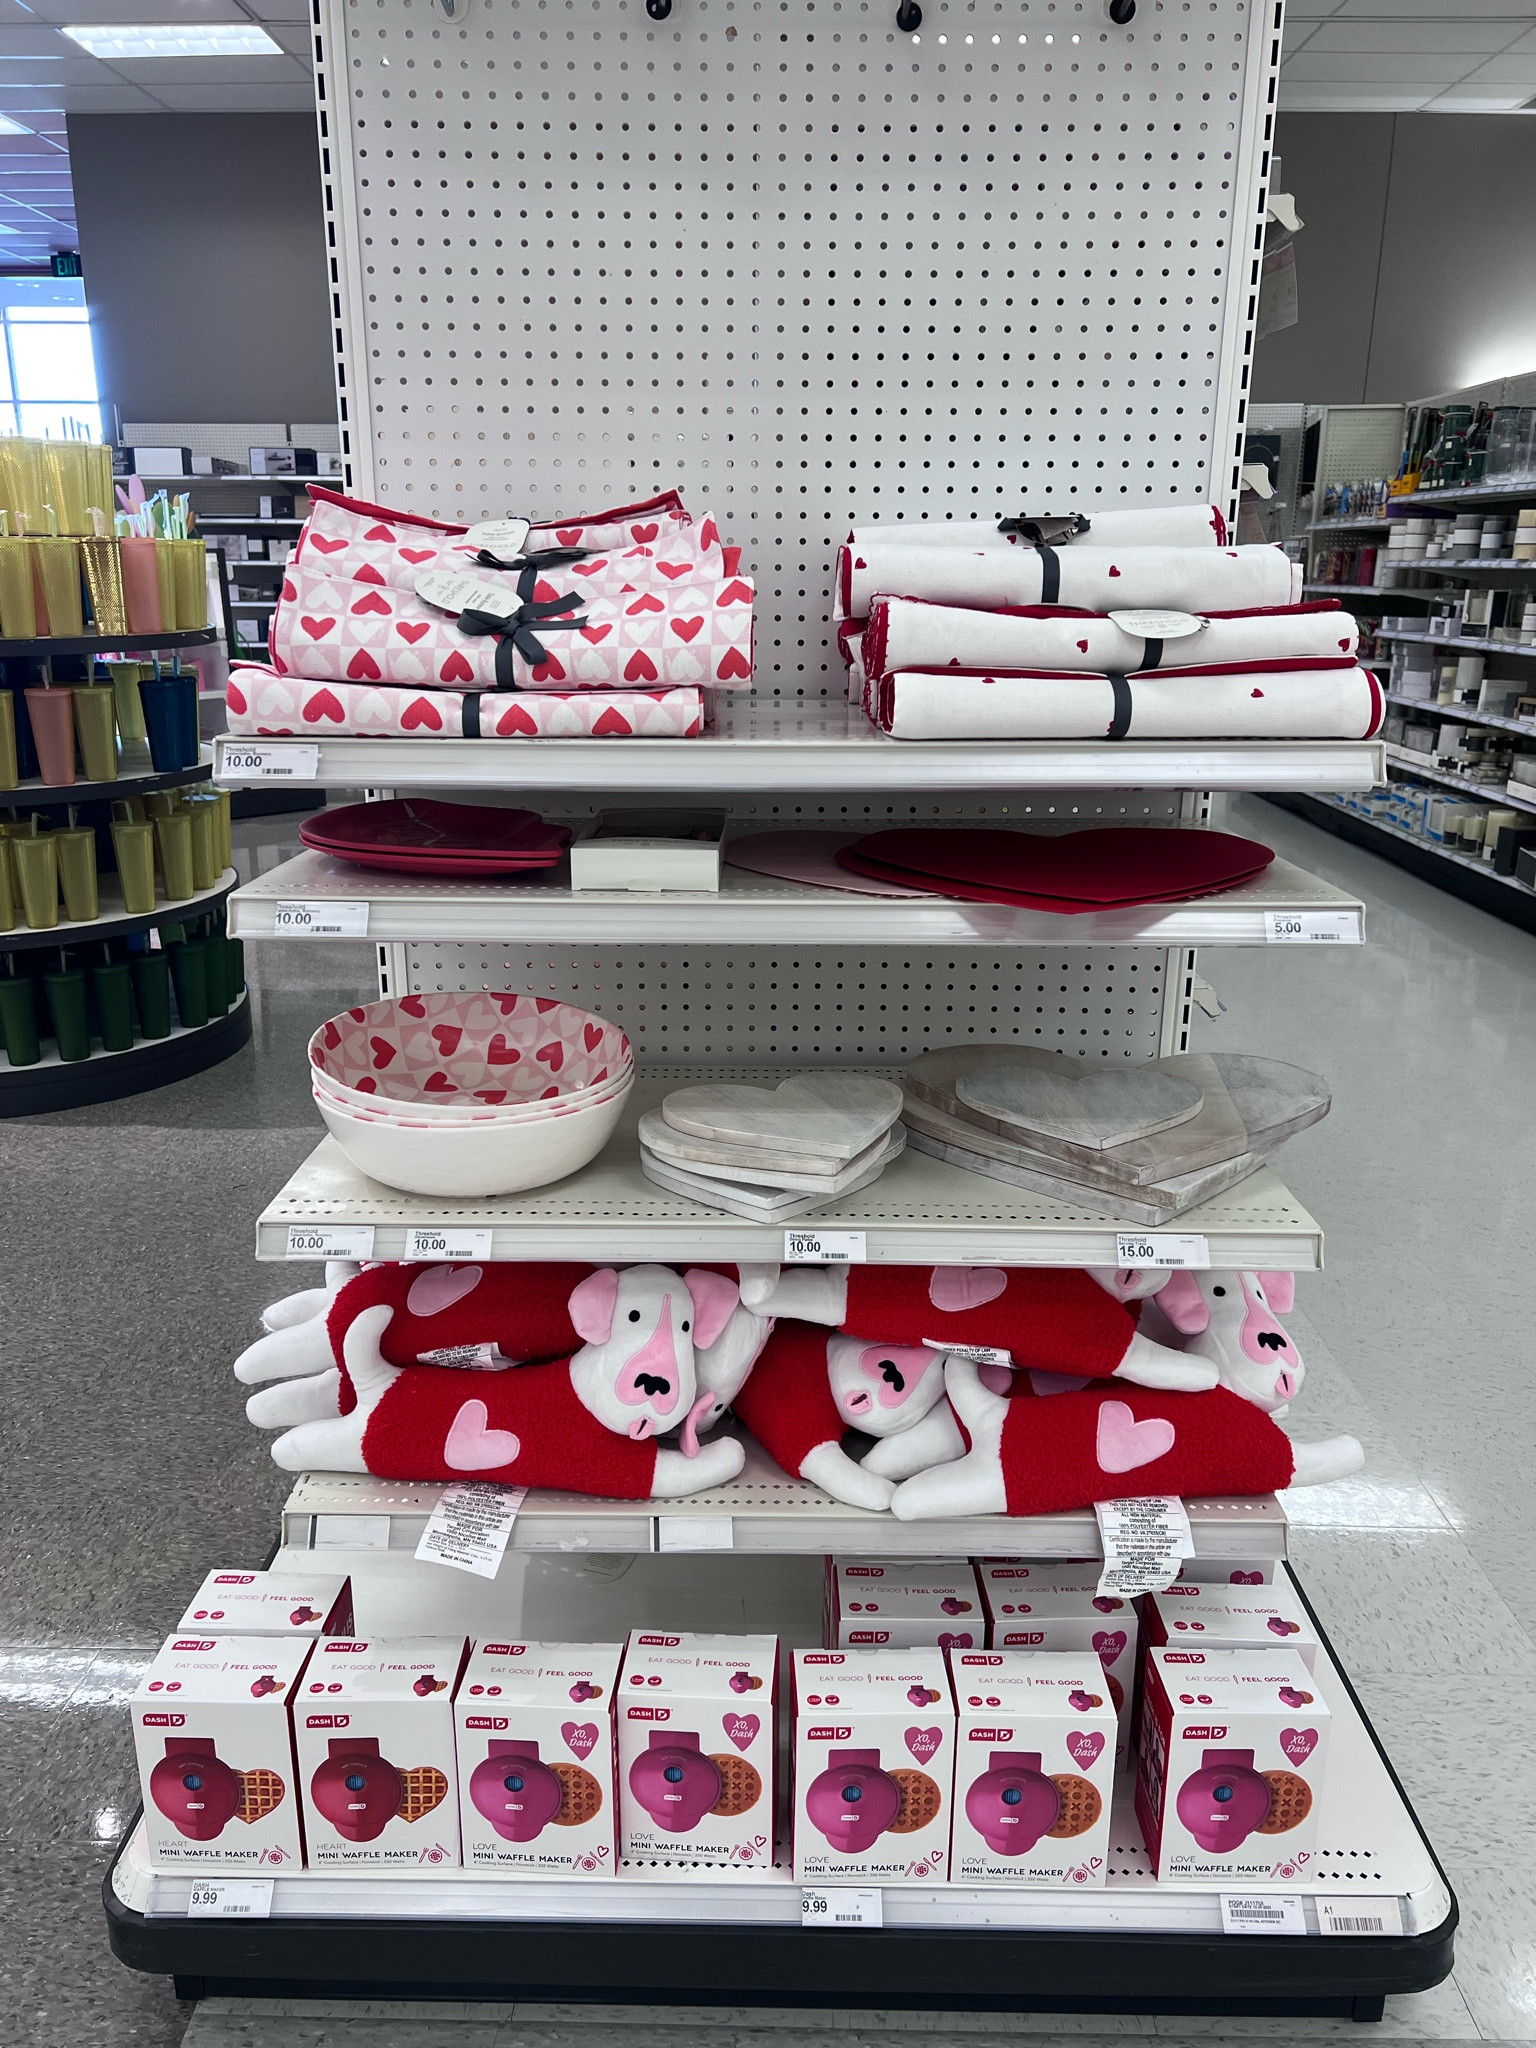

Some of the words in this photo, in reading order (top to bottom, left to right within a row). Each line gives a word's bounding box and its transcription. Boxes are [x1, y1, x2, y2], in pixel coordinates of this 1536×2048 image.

[56, 258, 77, 275] EXIT
[225, 755, 262, 767] 10.00
[276, 913, 312, 924] 10.00
[1274, 922, 1301, 933] 5.00
[290, 1237, 324, 1248] 10.00
[414, 1239, 446, 1250] 10.00
[789, 1242, 821, 1252] 10.00
[1120, 1246, 1154, 1257] 15.00
[448, 1539, 470, 1548] DELIVERY
[459, 1557, 473, 1565] CHINA
[1102, 1637, 1116, 1646] XO,
[733, 1720, 749, 1731] XO,
[572, 1729, 587, 1739] XO,
[730, 1728, 754, 1739] Dash
[915, 1733, 930, 1743] XO,
[568, 1738, 593, 1748] Dash
[1076, 1738, 1093, 1749] XO,
[1290, 1735, 1306, 1745] XO,
[911, 1742, 936, 1752] Dash
[1073, 1748, 1097, 1757] Dash
[1286, 1744, 1310, 1754] Dash
[472, 1843, 497, 1851] LOVE
[654, 1843, 692, 1852] WAFFLE
[696, 1845, 730, 1854] MAKER
[473, 1852, 494, 1860] MINI
[497, 1853, 535, 1862] WAFFLE
[539, 1856, 573, 1864] MAKER
[962, 1857, 988, 1865] LOVE
[961, 1866, 983, 1874] MINI
[986, 1867, 1025, 1875] WAFFLE
[1029, 1869, 1064, 1877] MAKER
[192, 1892, 217, 1904] 9.99
[802, 1900, 827, 1913] 9.99
[1324, 1906, 1333, 1914] A1
